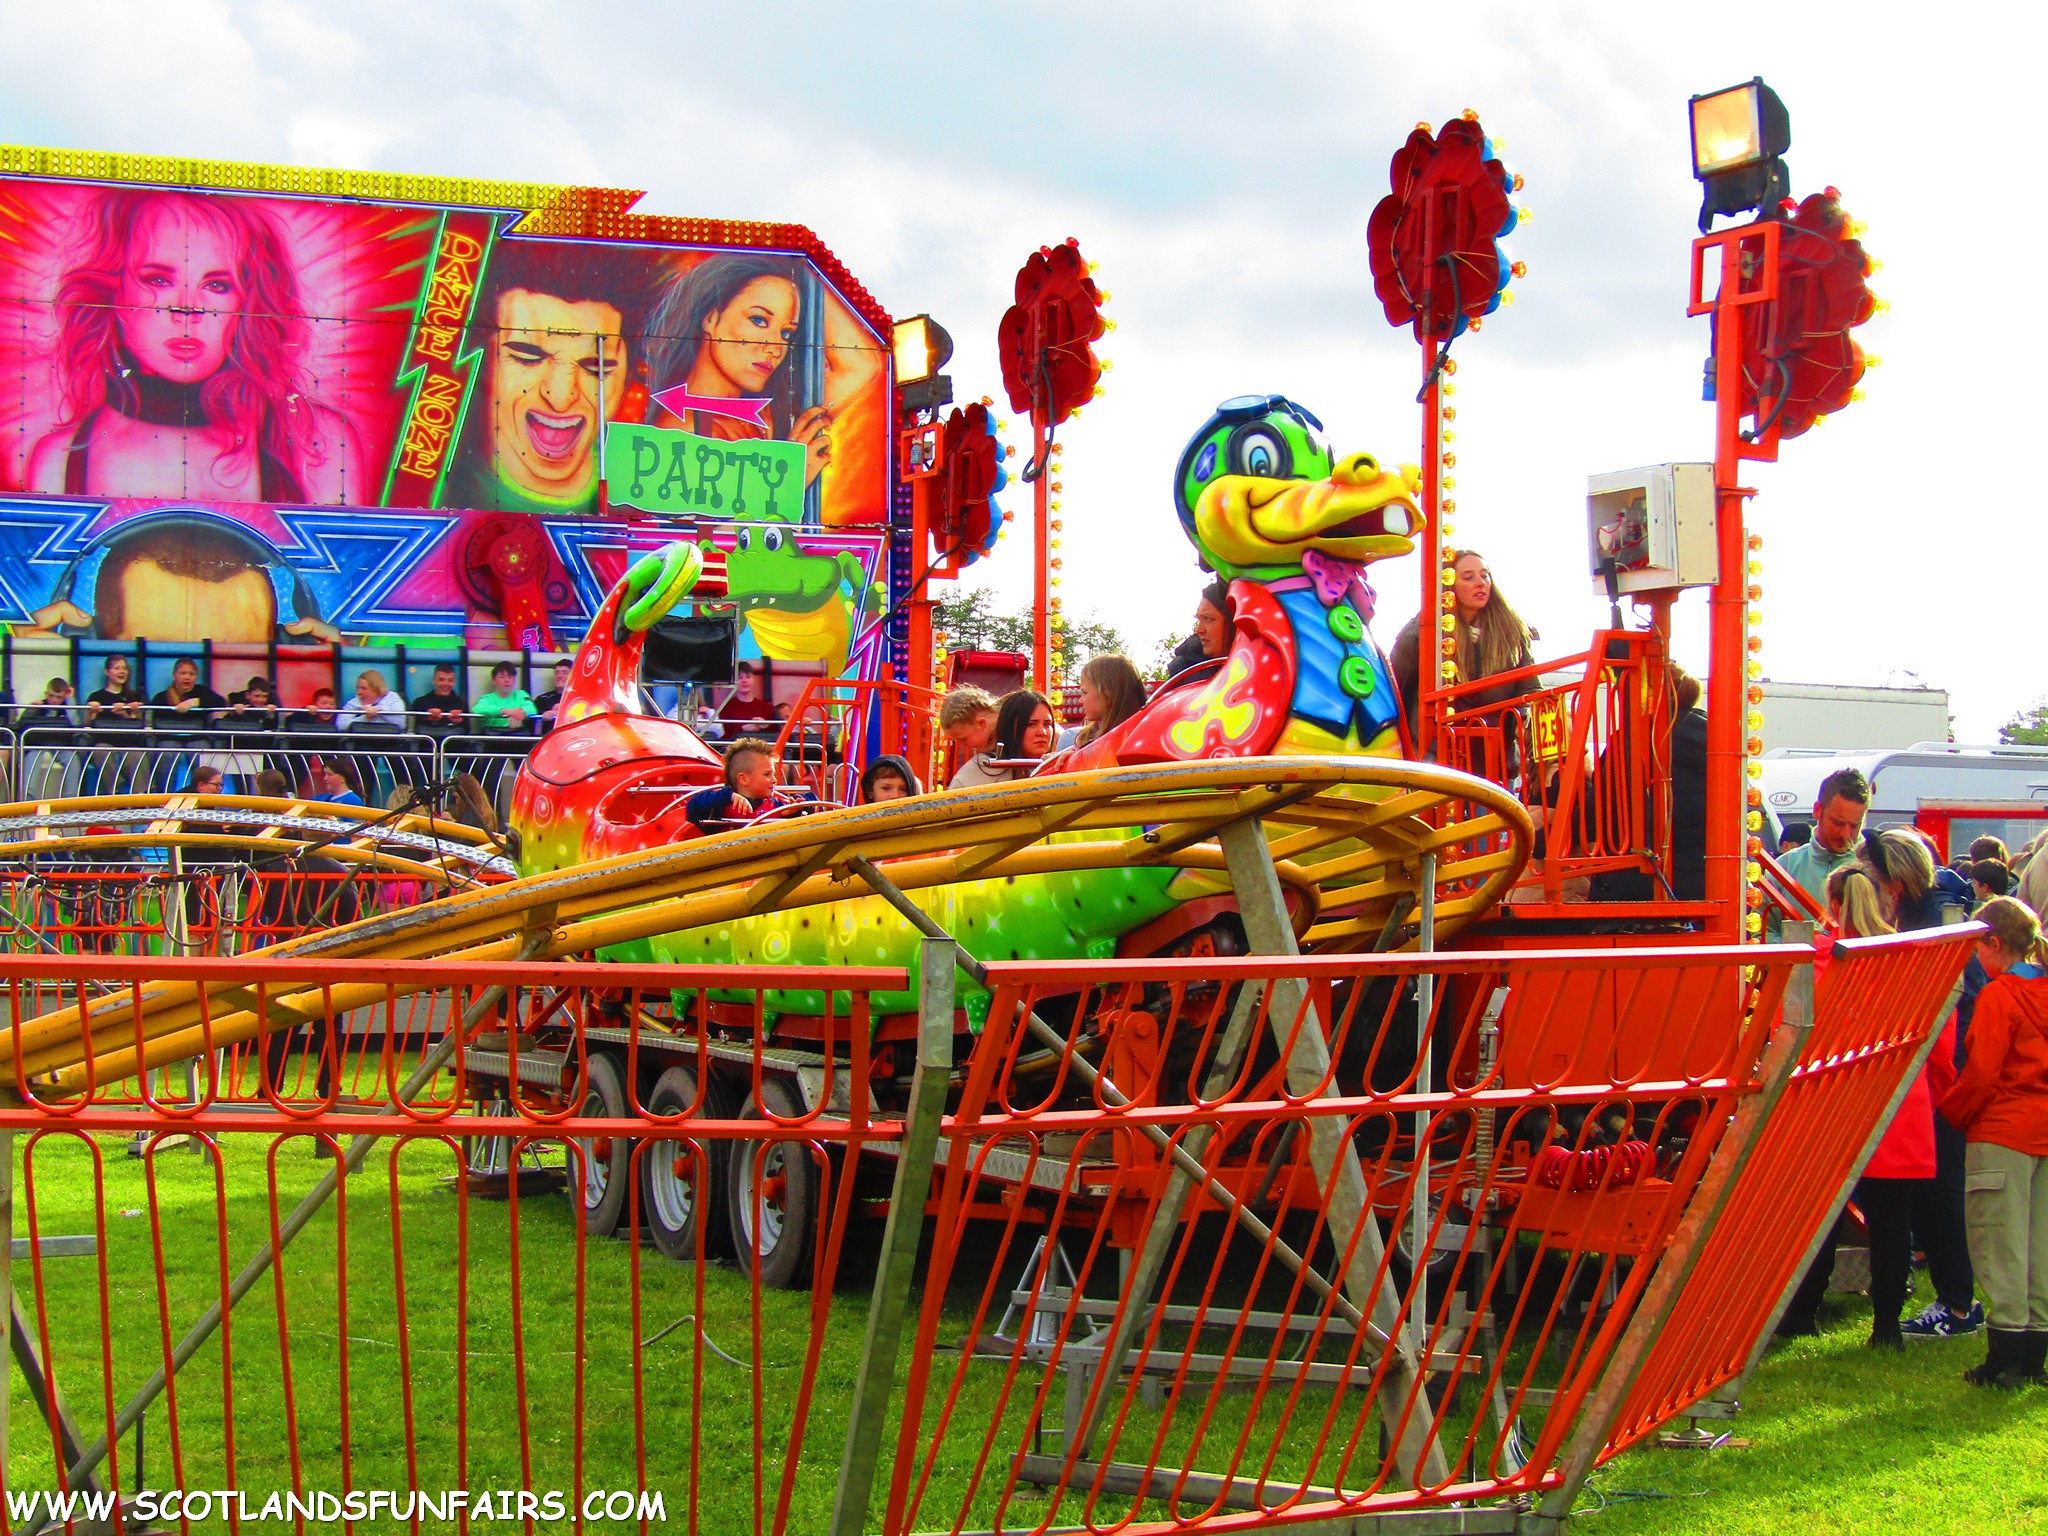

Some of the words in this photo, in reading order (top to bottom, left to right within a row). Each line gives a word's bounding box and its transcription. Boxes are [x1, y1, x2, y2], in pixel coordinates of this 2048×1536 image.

[416, 231, 482, 361] DANCE
[401, 374, 461, 478] ZONE
[630, 435, 788, 514] PARTY
[1774, 794, 1792, 803] LMC
